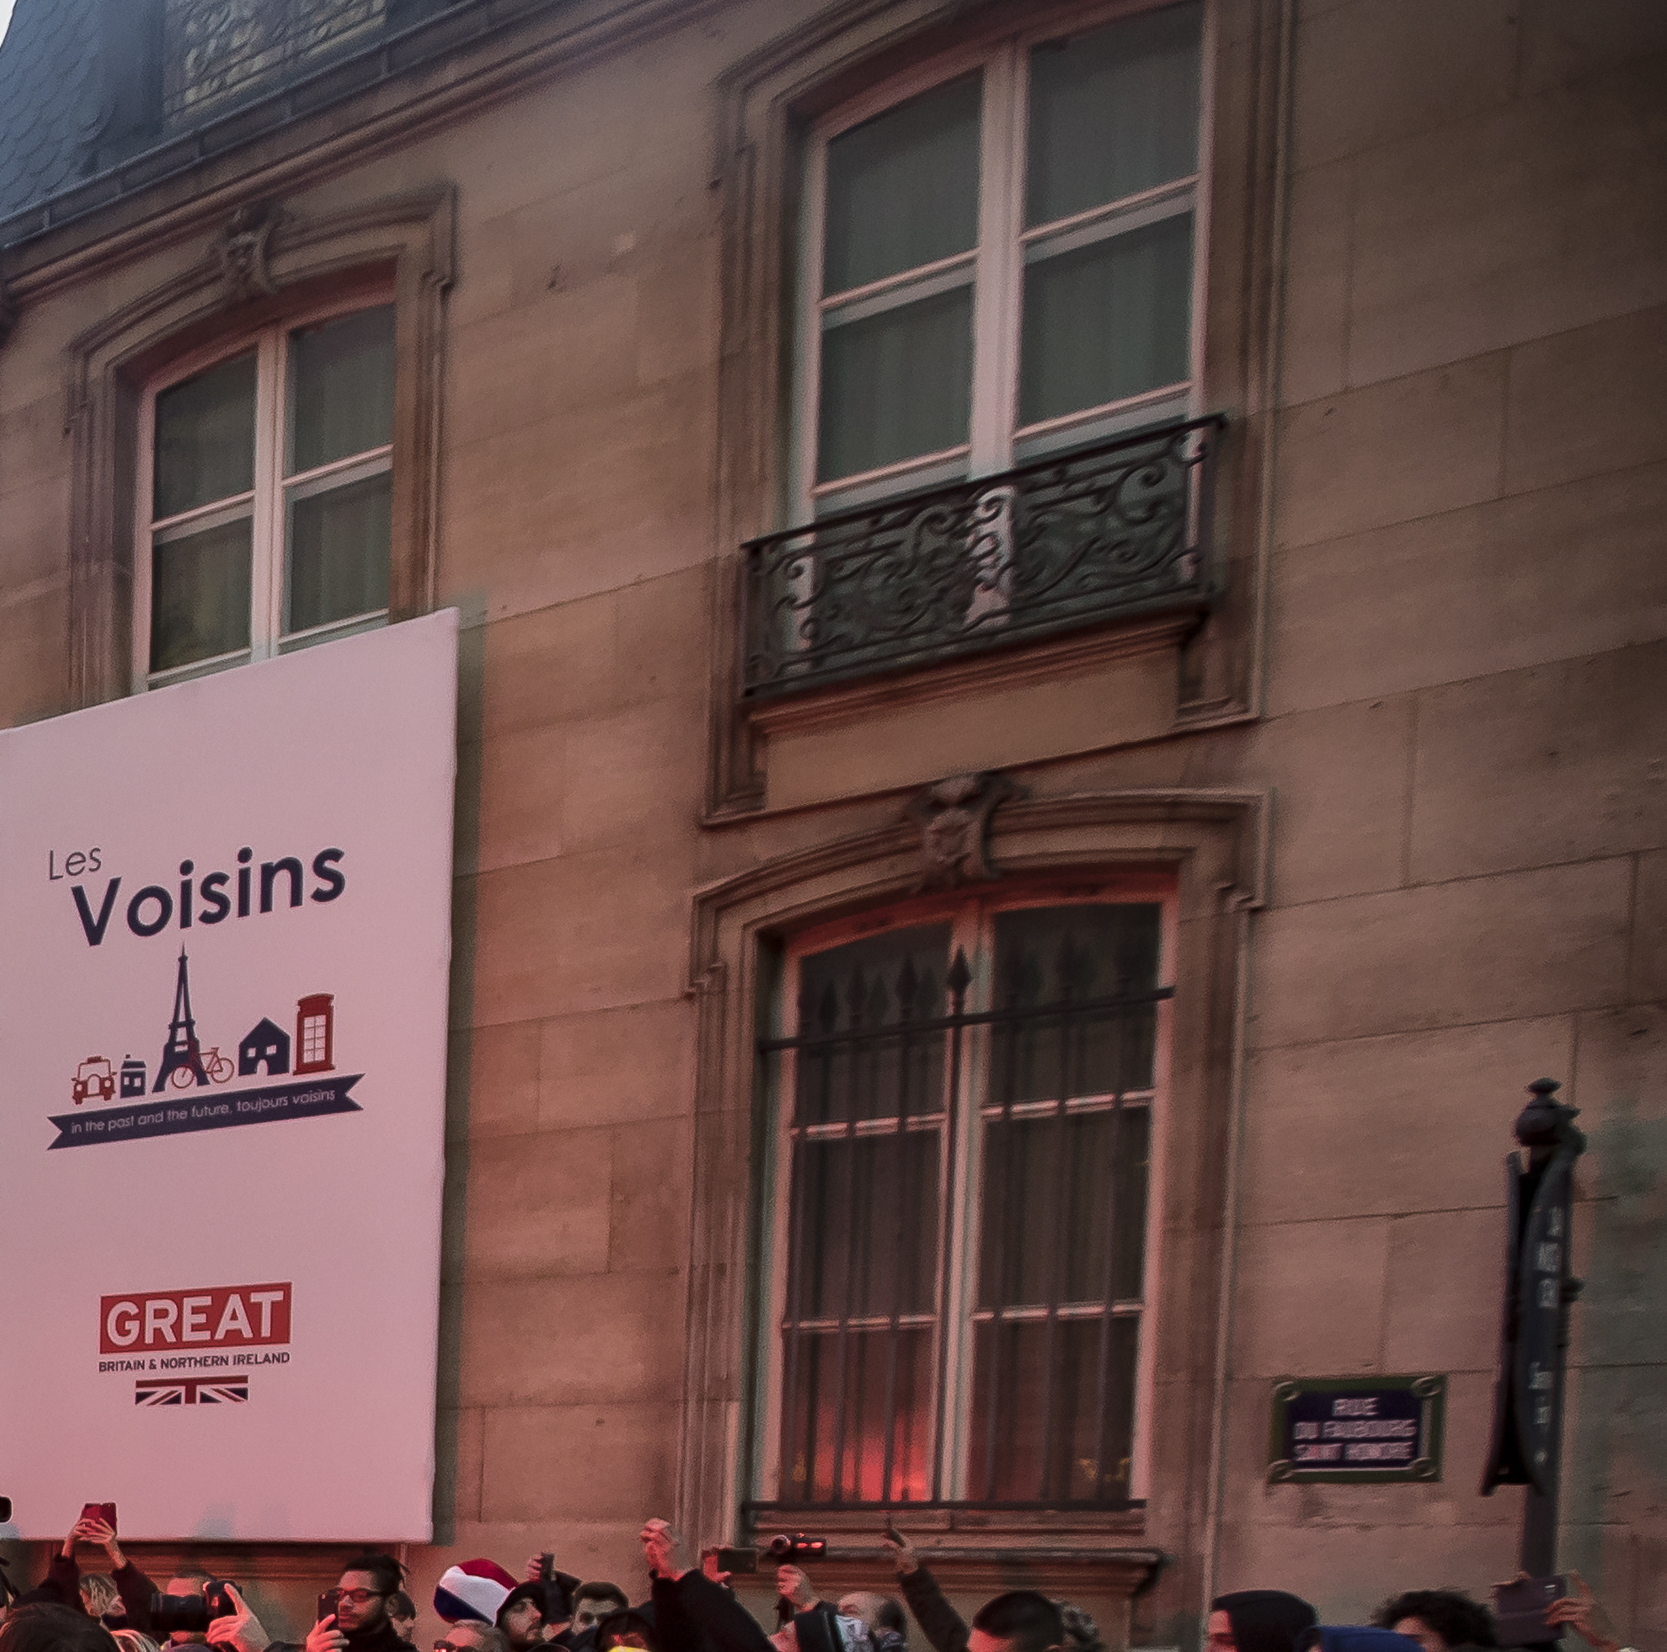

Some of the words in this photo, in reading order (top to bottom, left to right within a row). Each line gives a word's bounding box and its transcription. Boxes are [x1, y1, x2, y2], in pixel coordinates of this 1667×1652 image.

[49, 847, 102, 880] Les
[71, 846, 346, 947] Voisins
[71, 1121, 82, 1134] in
[85, 1118, 105, 1132] the
[108, 1116, 135, 1131] past
[138, 1112, 164, 1126] and
[167, 1108, 188, 1122] the
[237, 1095, 288, 1113] toujours
[292, 1089, 335, 1105] voisins
[107, 1290, 284, 1346] GREAT
[99, 1359, 145, 1372] BRITAIN
[148, 1359, 157, 1370] &
[160, 1355, 230, 1369] NORTHERN
[233, 1352, 290, 1366] IRELAND
